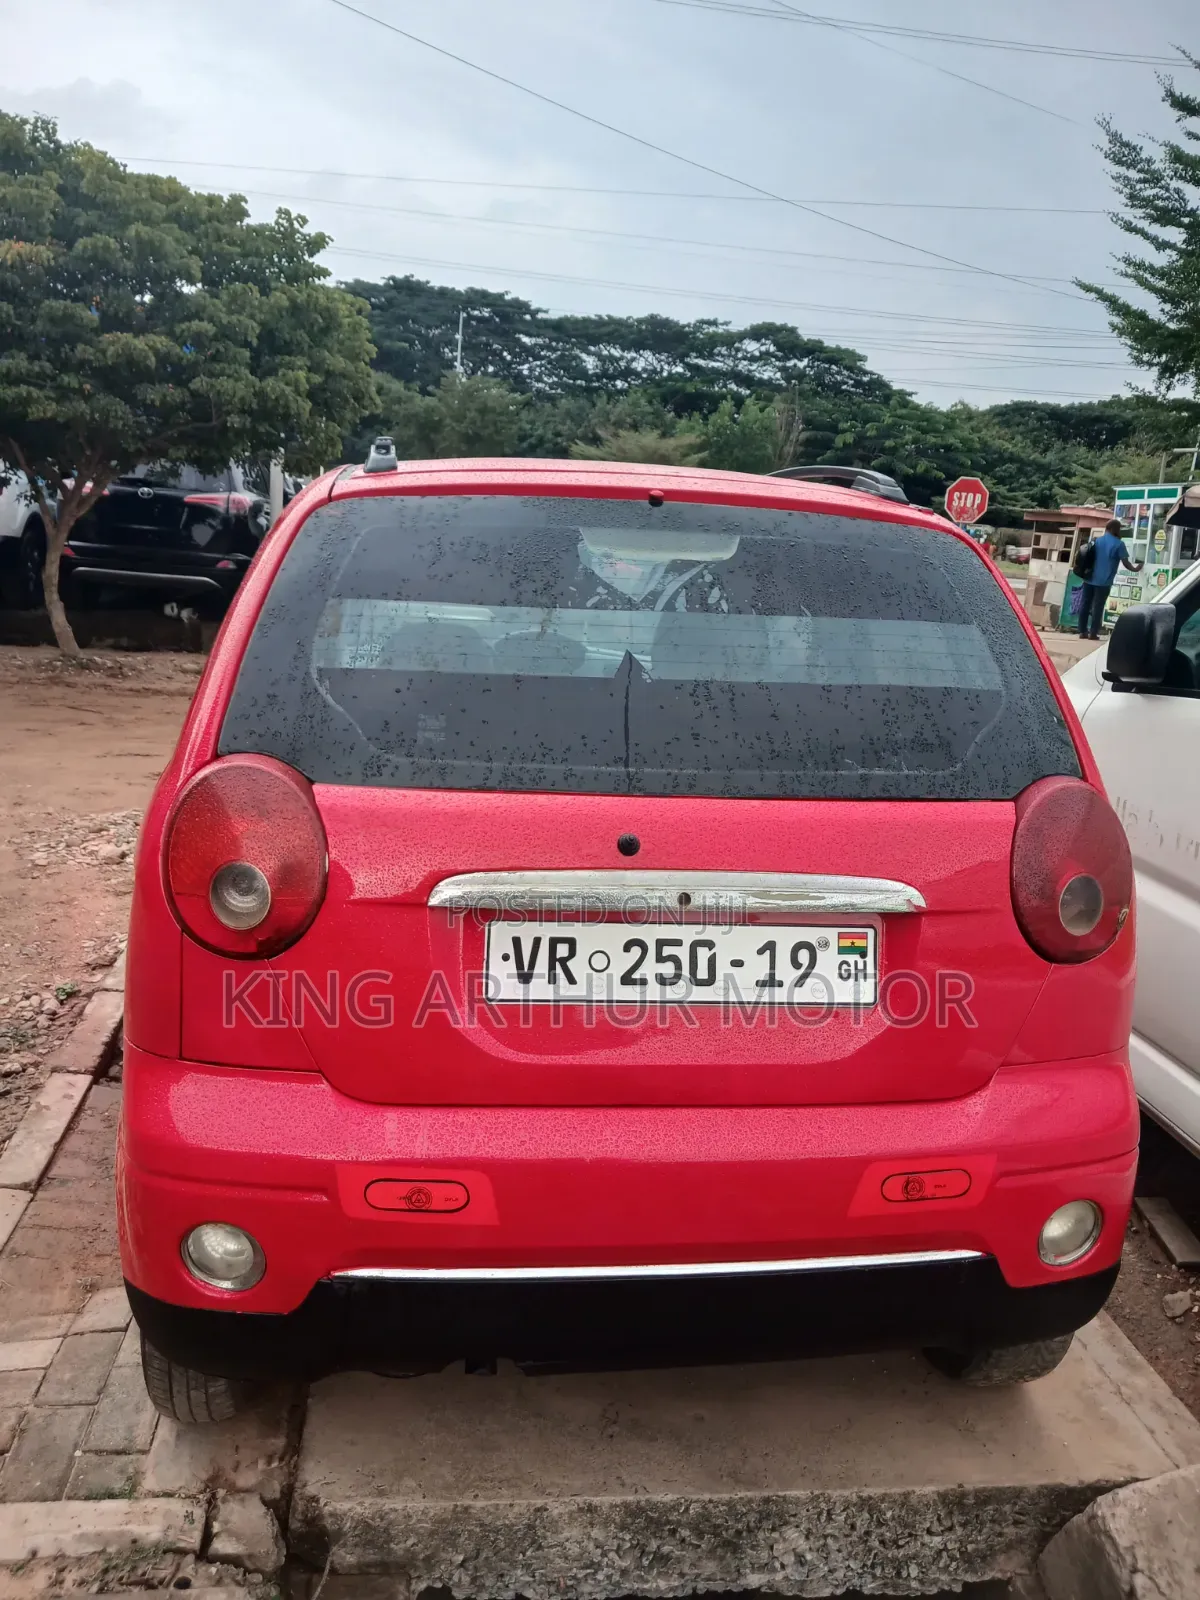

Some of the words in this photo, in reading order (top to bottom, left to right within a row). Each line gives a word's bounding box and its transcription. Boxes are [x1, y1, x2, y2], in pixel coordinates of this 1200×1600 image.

[953, 491, 982, 509] STOP
[511, 936, 578, 986] VR
[837, 959, 867, 982] GH
